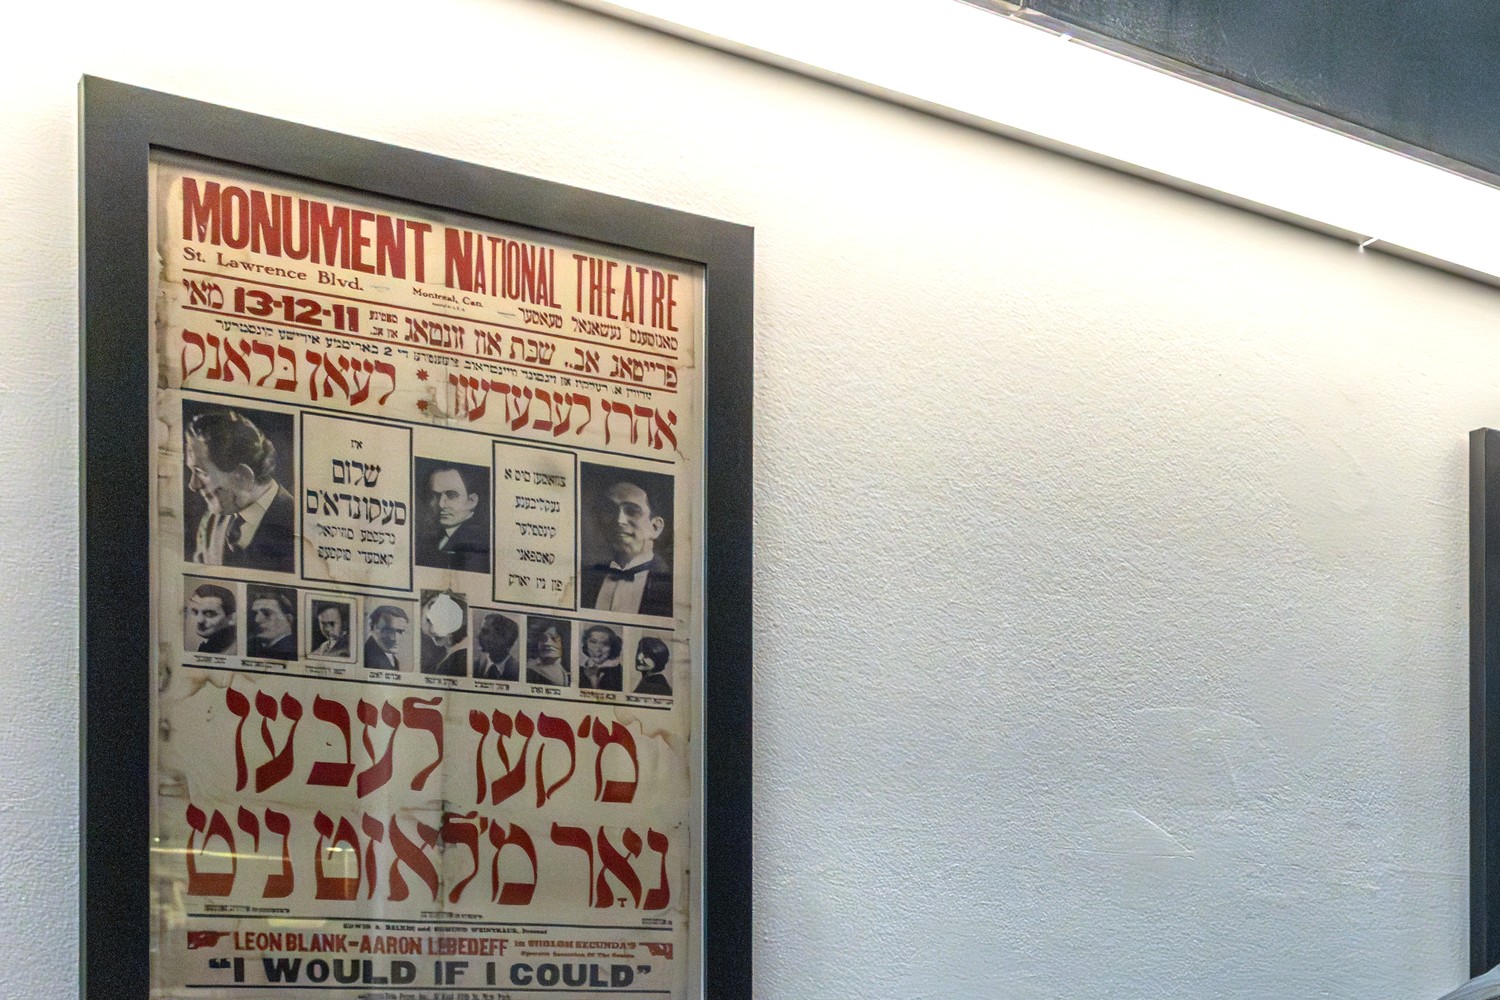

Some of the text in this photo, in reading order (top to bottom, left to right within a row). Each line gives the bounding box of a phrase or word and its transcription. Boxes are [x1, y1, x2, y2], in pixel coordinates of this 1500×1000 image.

[182, 177, 679, 332] MONUMENT NATIONAL THEATRE
[183, 247, 364, 291] St. Lawrence Blvd.
[332, 458, 382, 488] שלום
[186, 803, 295, 898] ניט
[233, 931, 282, 952] LEON
[427, 937, 509, 957] LEBEDEFF
[262, 957, 417, 985] WOULD
[434, 960, 469, 986] IF
[485, 961, 496, 986] I
